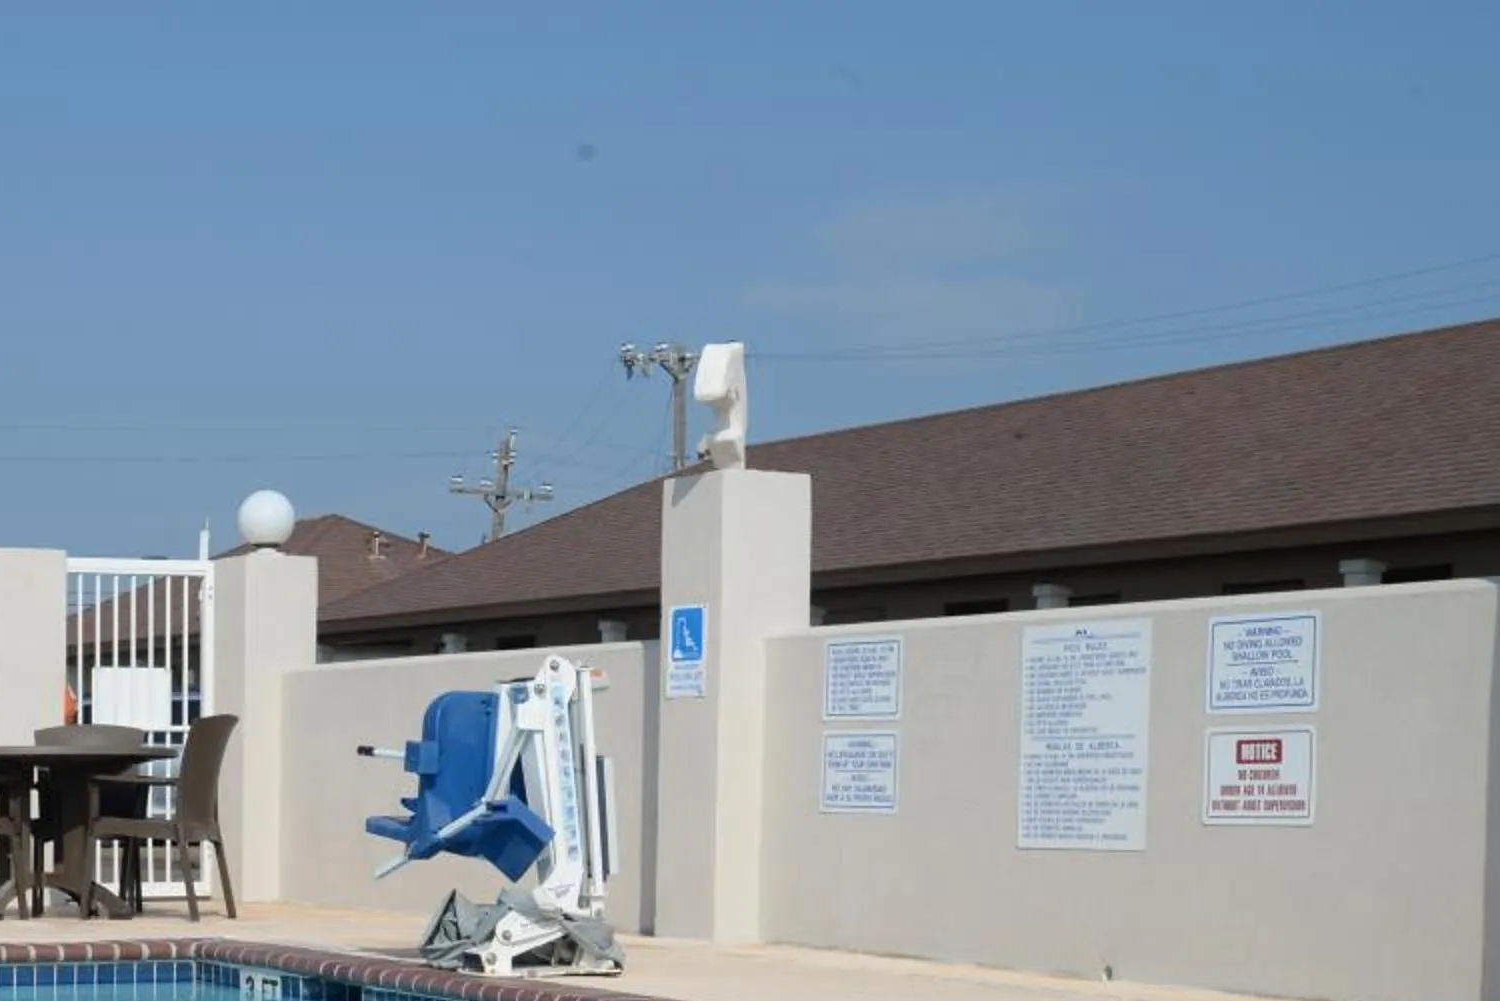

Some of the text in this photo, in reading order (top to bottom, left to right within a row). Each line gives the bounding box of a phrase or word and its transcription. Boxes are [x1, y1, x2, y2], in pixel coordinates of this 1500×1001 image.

[1265, 635, 1303, 647] ALLOWED
[1271, 648, 1292, 659] POOL
[1241, 742, 1279, 761] NOTICE
